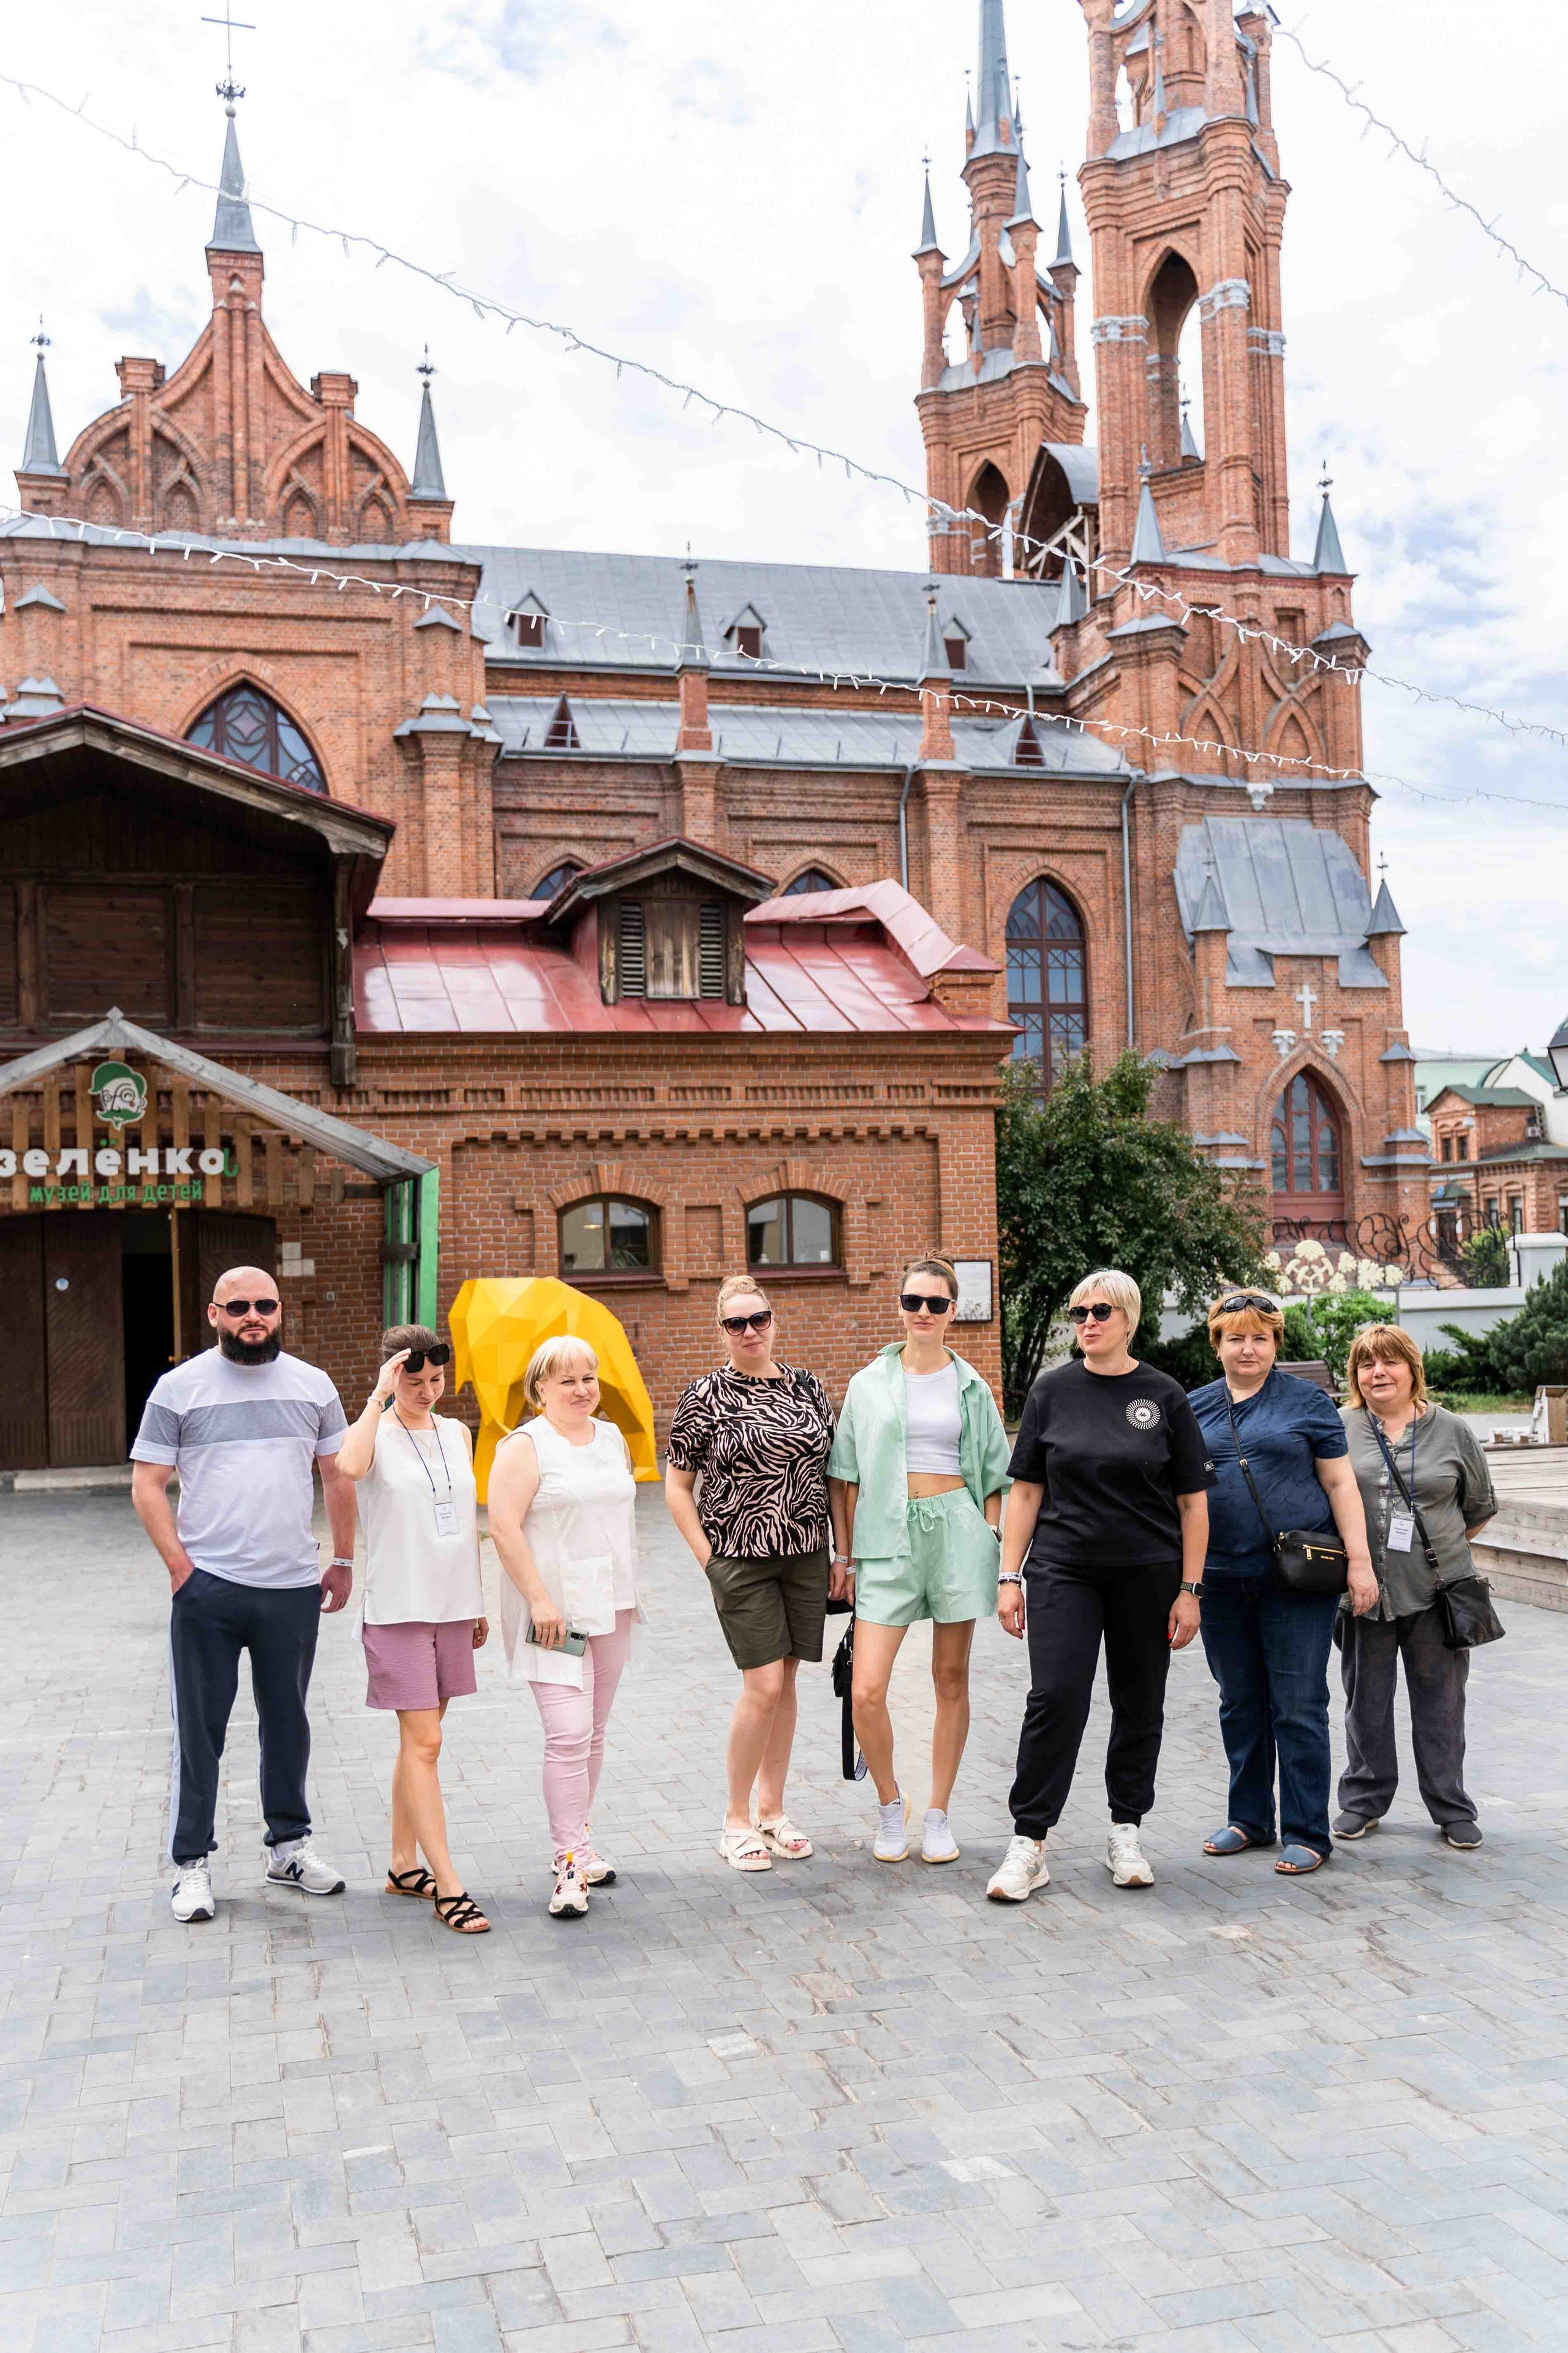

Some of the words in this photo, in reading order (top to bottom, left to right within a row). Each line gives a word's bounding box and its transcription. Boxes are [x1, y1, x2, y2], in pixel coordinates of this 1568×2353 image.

[30, 1180, 91, 1205] музей
[99, 1185, 136, 1205] для
[142, 1179, 202, 1203] детей
